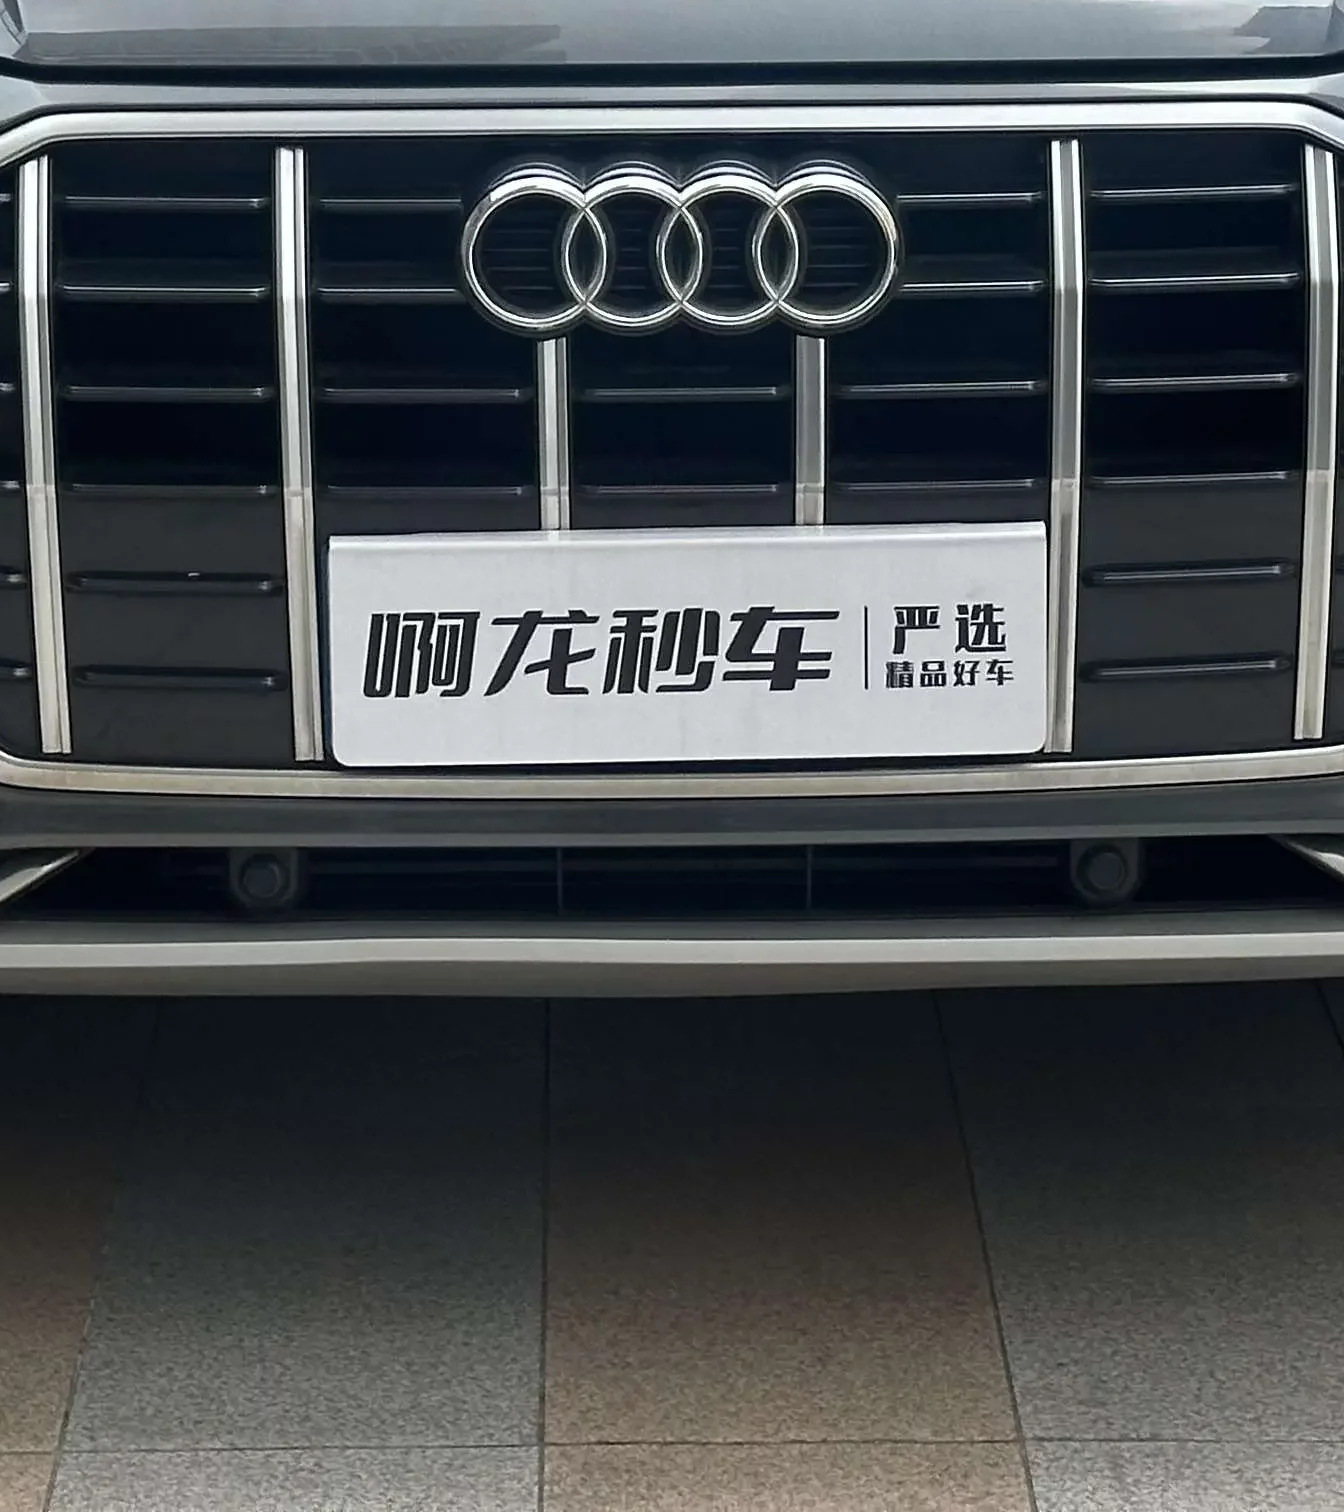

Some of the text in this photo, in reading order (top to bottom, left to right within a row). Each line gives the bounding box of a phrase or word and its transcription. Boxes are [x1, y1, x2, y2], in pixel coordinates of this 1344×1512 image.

[363, 605, 840, 698] 啊龙秒车
[892, 603, 1007, 655] 严选
[885, 659, 1014, 689] 精品好车
